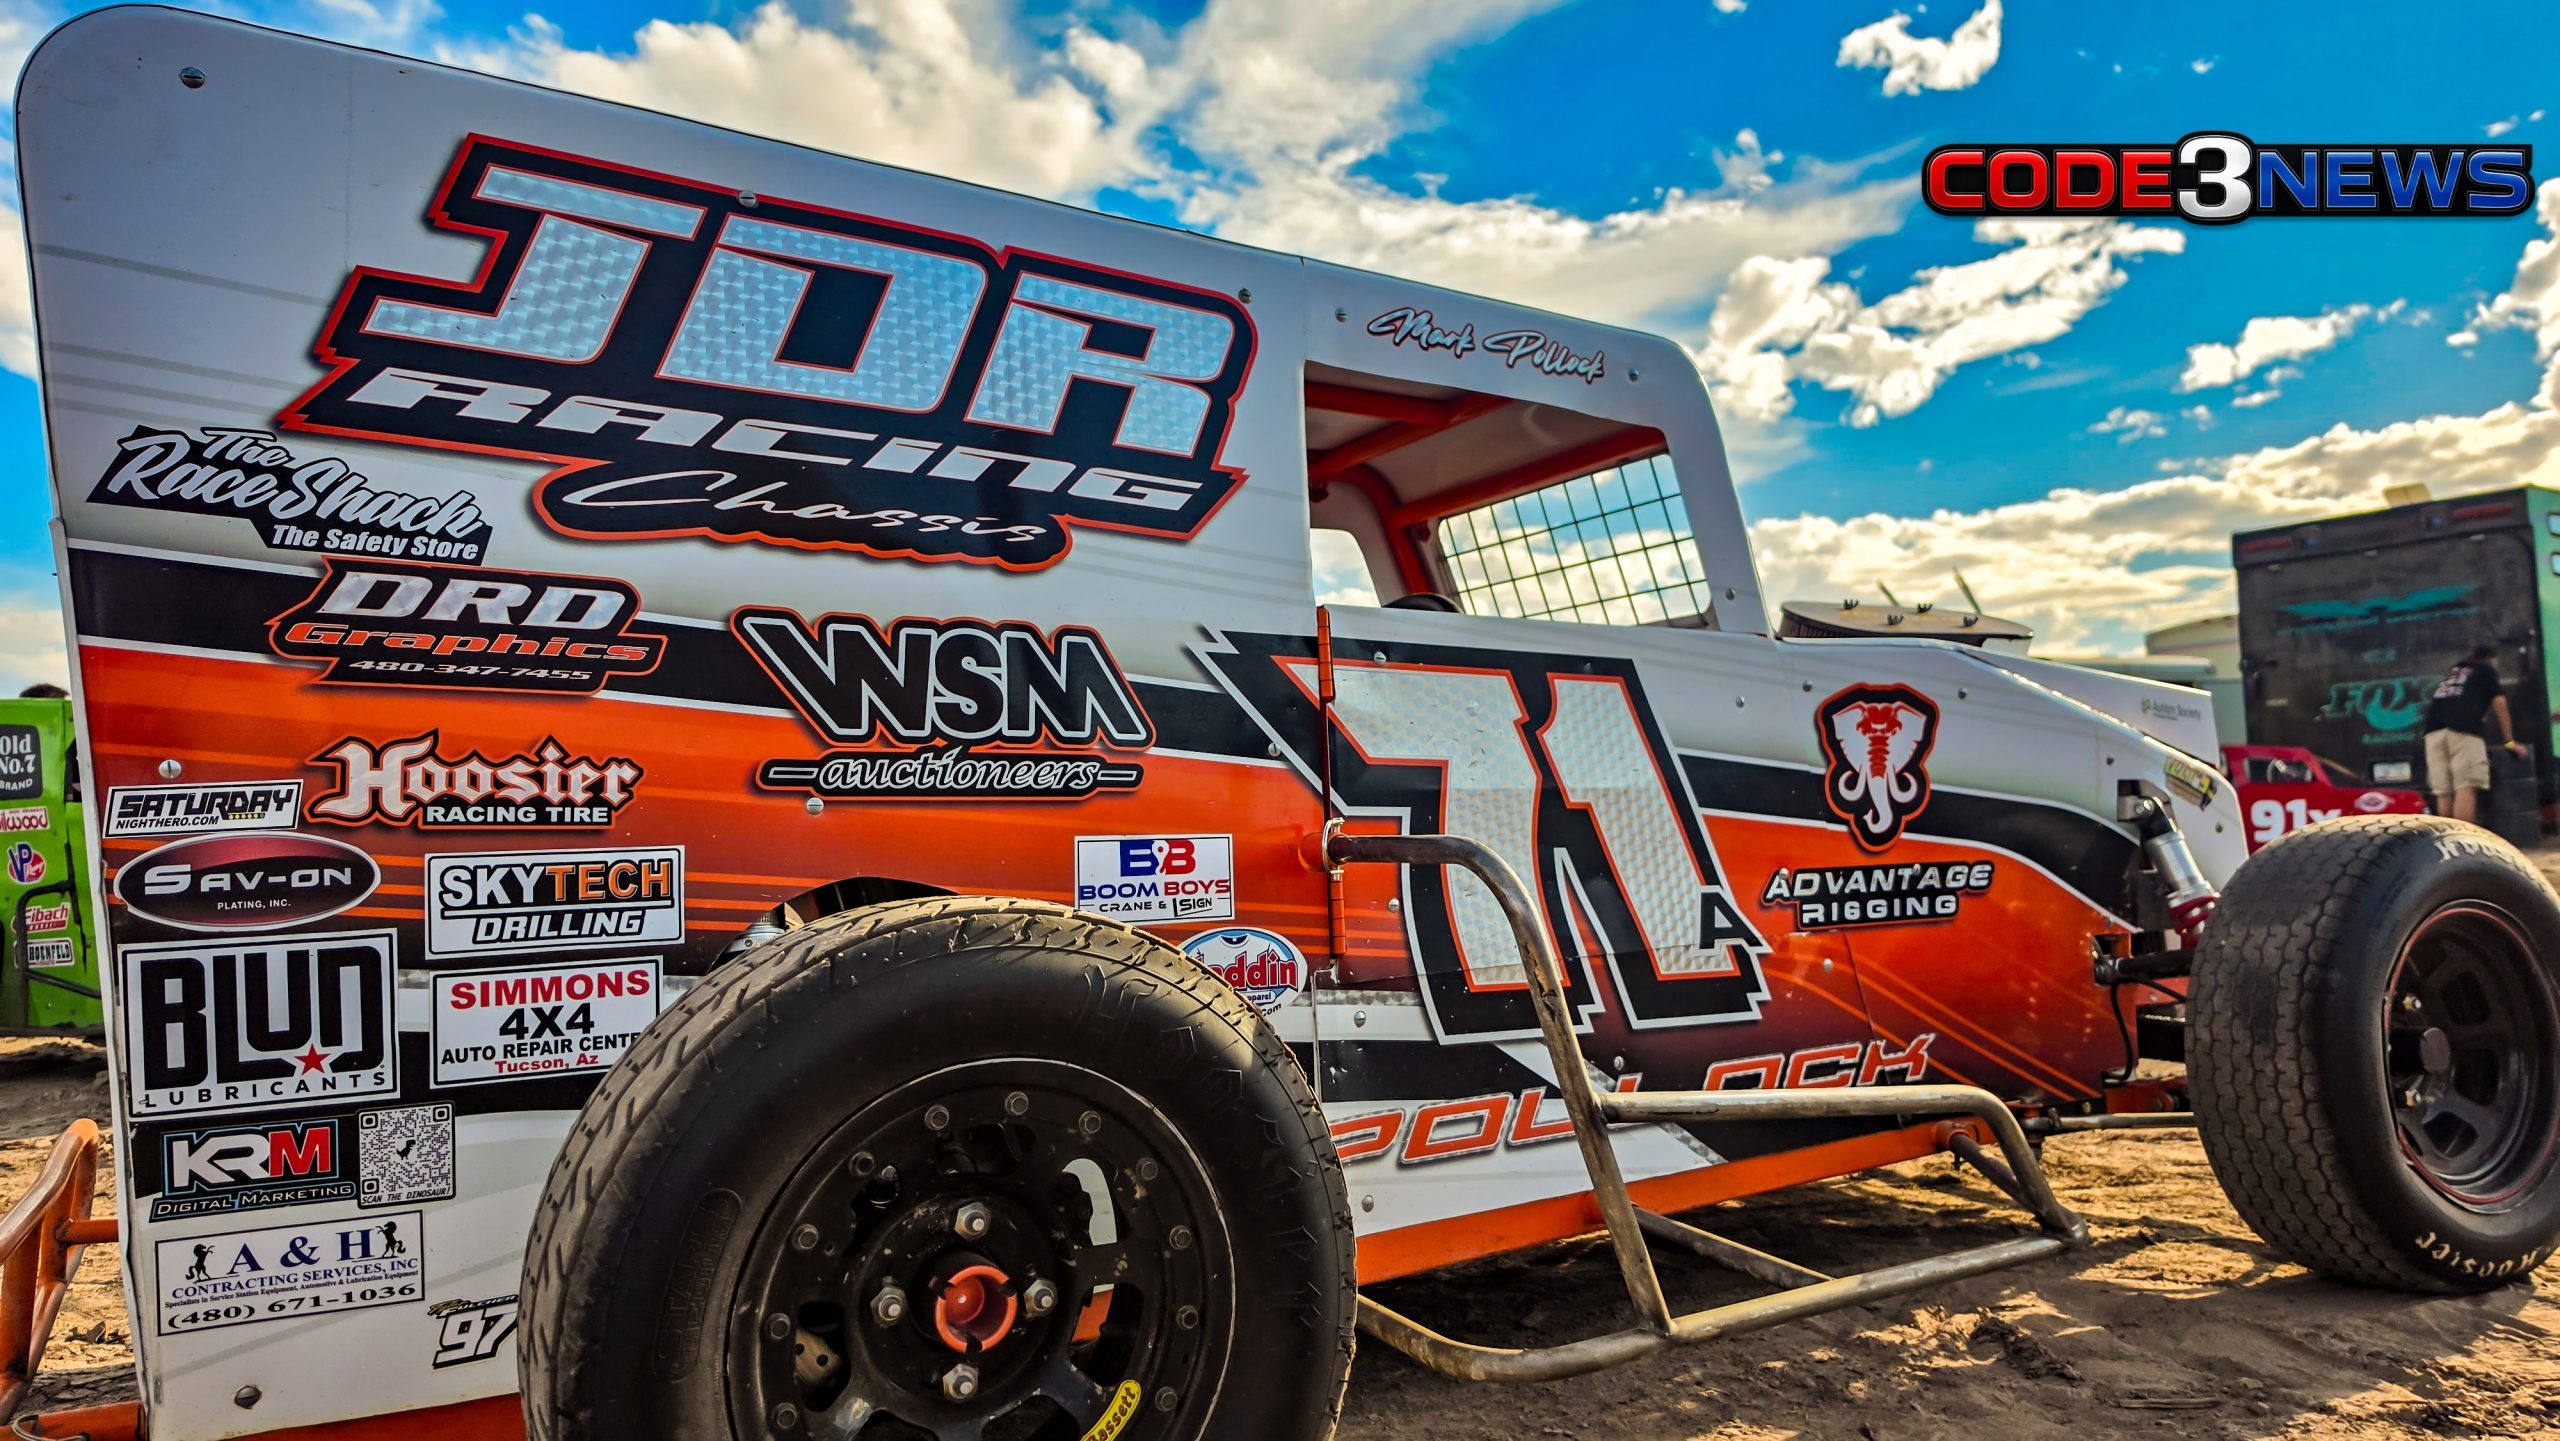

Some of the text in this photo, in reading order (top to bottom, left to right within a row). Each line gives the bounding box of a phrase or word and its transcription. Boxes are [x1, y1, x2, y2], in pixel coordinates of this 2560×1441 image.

[360, 163, 1236, 458] JDR
[1368, 307, 1605, 385] Mark Pollock
[202, 429, 289, 467] The
[345, 368, 1205, 512] RACING
[562, 466, 1049, 543] Chassis
[272, 525, 479, 560] The Safety Store
[319, 570, 626, 630] DRD
[284, 622, 650, 661] Graphics
[348, 657, 593, 681] 480-347-7455
[742, 617, 1148, 744] WSM
[0, 733, 32, 755] Old
[315, 736, 640, 817] Hoosier
[818, 748, 1098, 792] auctioneers
[0, 808, 48, 831] ilwood
[116, 815, 220, 829] NIGHTHERO.COM
[117, 789, 295, 820] SATURDAY
[426, 806, 609, 823] RACING TIRE
[144, 864, 352, 895] SAV-ON
[442, 861, 671, 908] SKYTECH
[1079, 879, 1231, 900] BOOM BOYS
[1765, 864, 1992, 899] ADVANTAGE
[217, 898, 292, 911] PLATING, INC.
[1099, 897, 1213, 912] CRANE & SIGN
[1801, 895, 1957, 924] RIGGING
[475, 910, 643, 942] DRILLING
[450, 969, 650, 1010] SIMMONS
[140, 945, 384, 1091] BLUD
[499, 1002, 595, 1041] 4X4
[441, 1032, 641, 1065] AUTO REPAIR CENTE
[495, 1053, 599, 1074] Tucson, Az
[143, 1071, 386, 1108] LUBRICANTS
[171, 1126, 331, 1188] KRM
[156, 1184, 353, 1216] DIGITAL MARKETING
[361, 1186, 451, 1205] SCAN THE DINOSAUR!
[226, 1228, 376, 1275] A & H
[165, 1298, 200, 1309] Specialists
[210, 1294, 234, 1302] Service
[235, 1290, 259, 1299] Station
[299, 1281, 337, 1290] Automotive
[346, 1275, 383, 1284] Lubrication
[384, 1270, 419, 1280] Equipment
[172, 1258, 418, 1299] CONTRACTING SERVICES, INC
[168, 1283, 416, 1329] (480) 671-1036
[434, 1301, 518, 1366] 97
